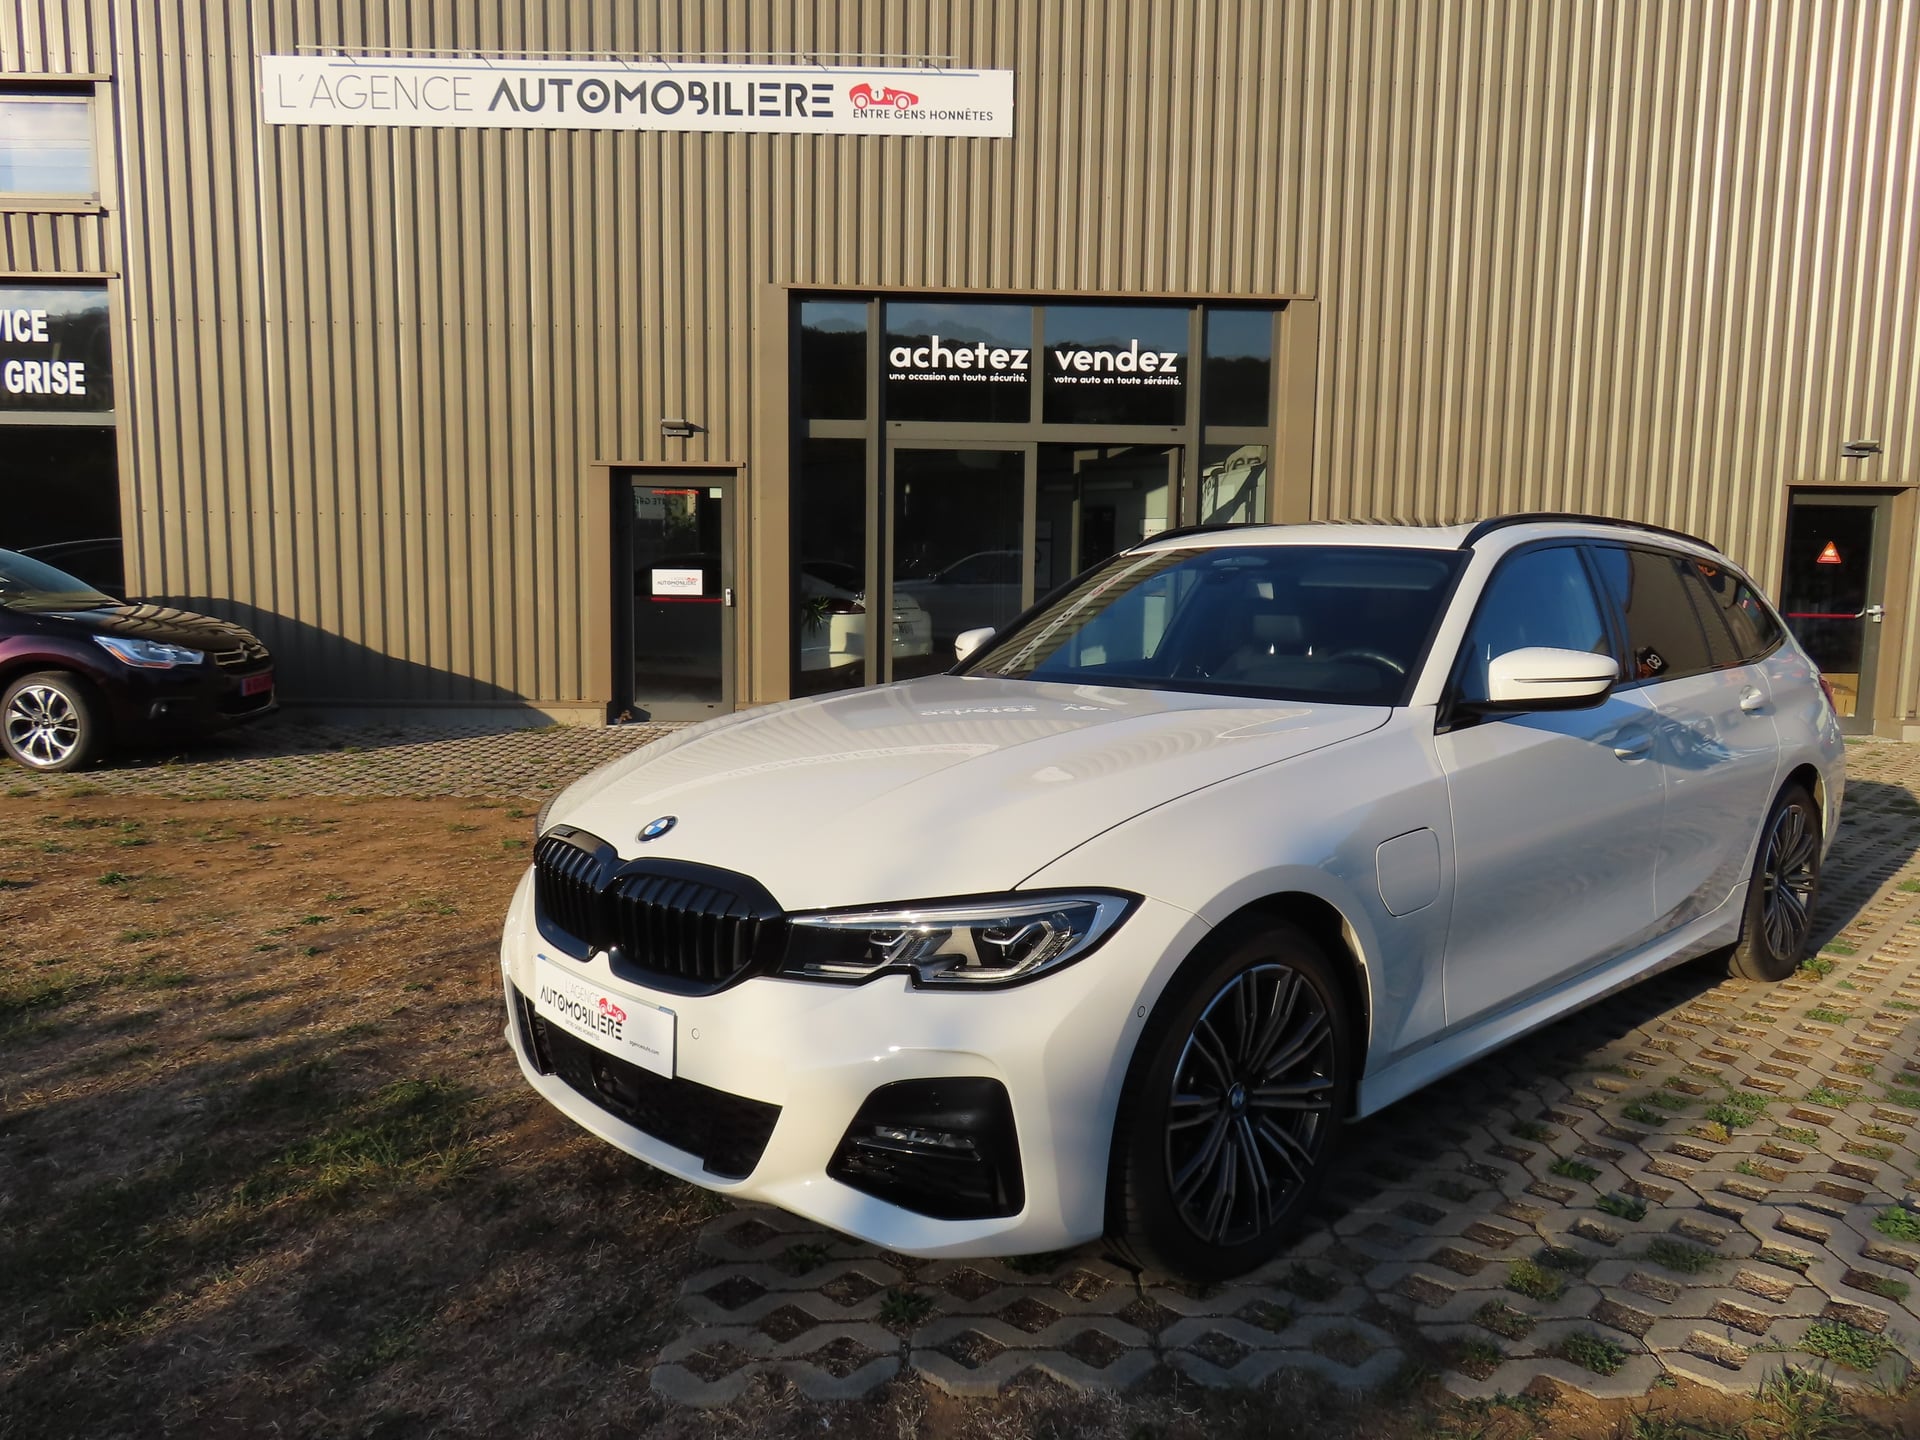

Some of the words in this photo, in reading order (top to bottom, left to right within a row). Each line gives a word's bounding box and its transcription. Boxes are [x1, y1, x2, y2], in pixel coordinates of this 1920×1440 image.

[278, 73, 474, 112] L'AGENCE
[487, 77, 834, 119] AUTOMOBILIERE
[853, 108, 891, 119] ENTRE
[894, 109, 926, 120] GENS
[929, 108, 993, 121] HONNÊTES
[889, 335, 1029, 370] achetez
[1054, 339, 1179, 373] vendez
[4, 360, 87, 395] GRISE
[889, 372, 906, 381] une
[908, 371, 947, 381] occasion
[949, 374, 960, 382] en
[963, 373, 987, 382] toute
[989, 372, 1028, 383] sécurité.
[1054, 375, 1078, 384] votre
[1080, 375, 1101, 384] auto
[1103, 377, 1115, 385] en
[1117, 376, 1141, 385] toute
[1143, 375, 1182, 386] sérénité.
[540, 985, 623, 1041] AUTOMOBILIERE
